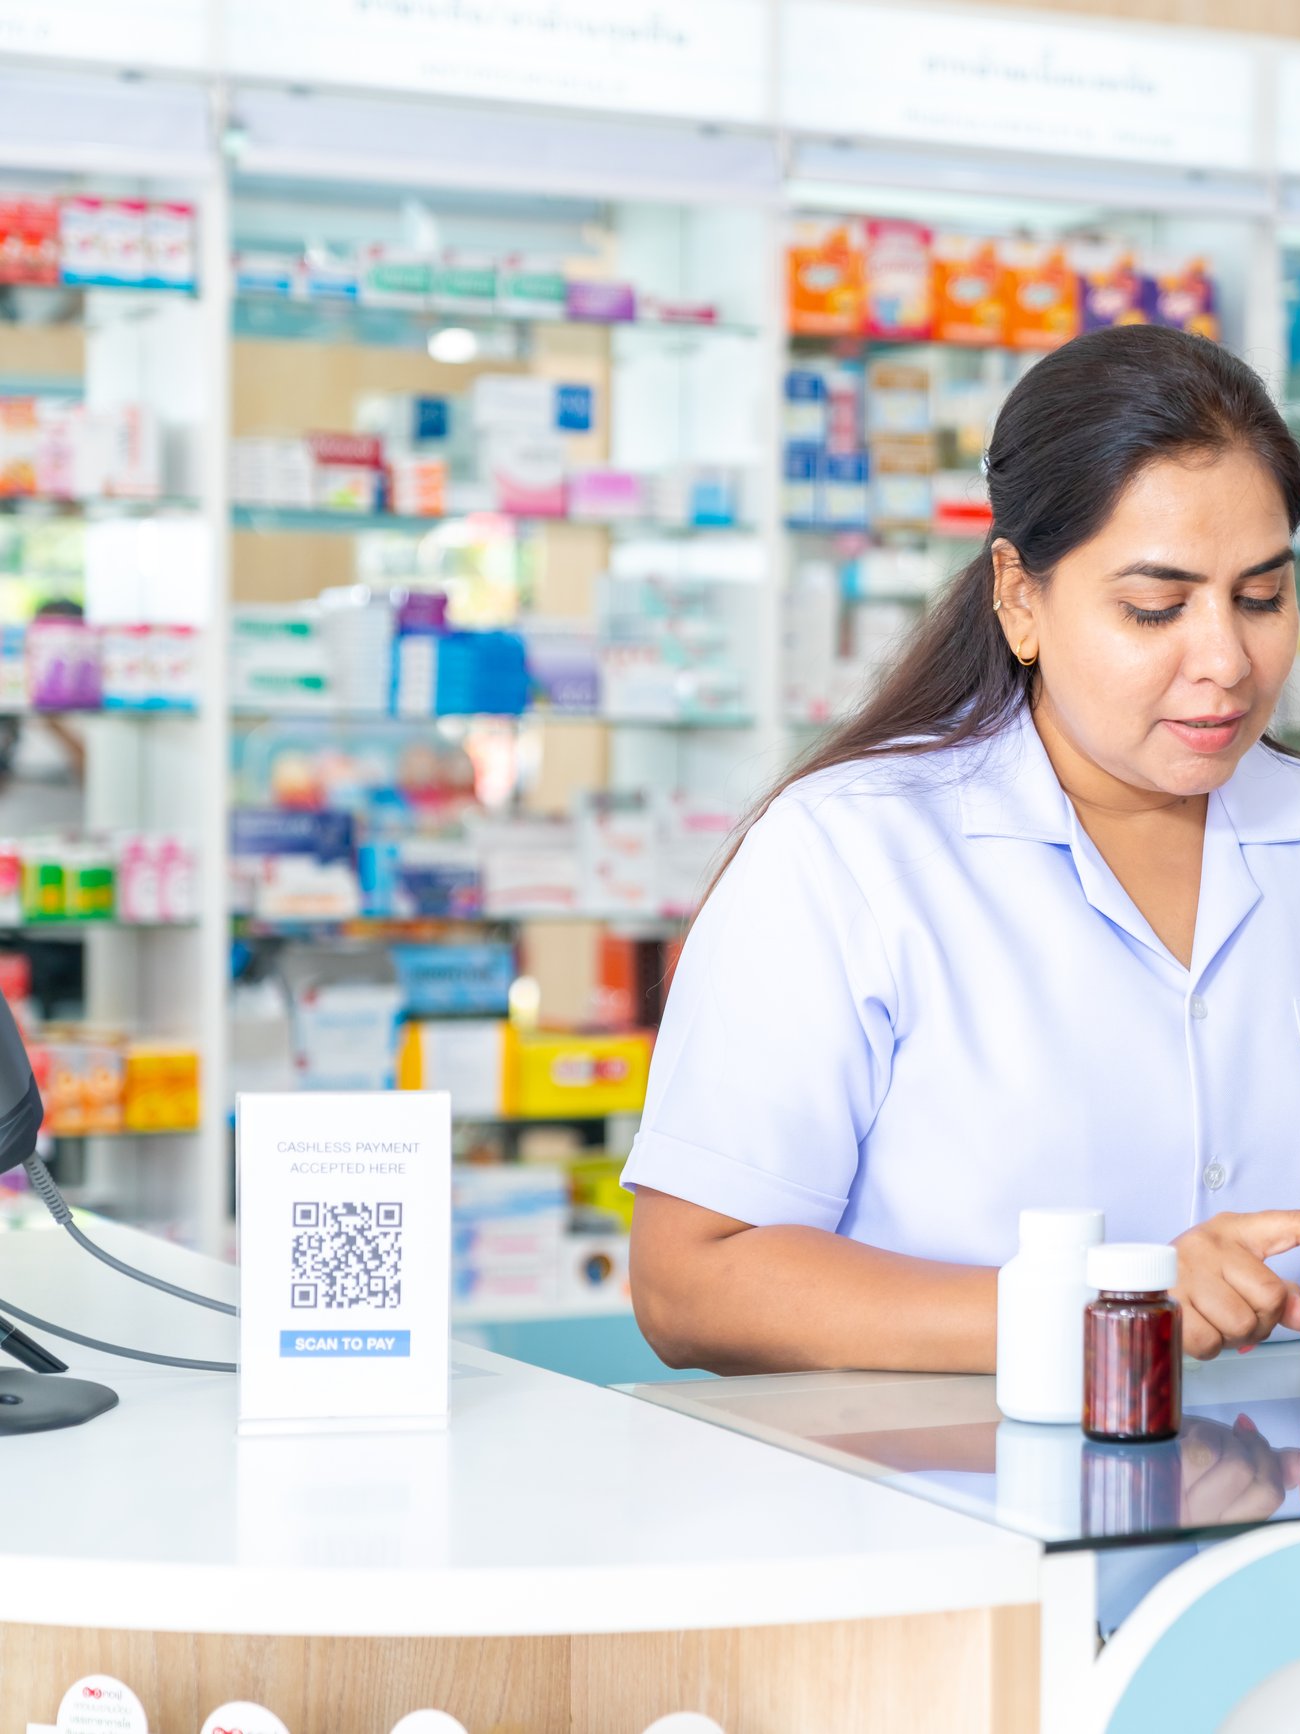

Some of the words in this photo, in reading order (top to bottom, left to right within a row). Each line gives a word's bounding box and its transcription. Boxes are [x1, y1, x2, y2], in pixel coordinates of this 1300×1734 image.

[277, 1141, 352, 1153] CASHLESS
[355, 1141, 420, 1154] PAYMENT
[290, 1162, 366, 1174] ACCEPTED
[369, 1162, 406, 1175] HERE
[294, 1337, 338, 1351] SCAN
[341, 1337, 363, 1351] TO
[366, 1337, 396, 1350] PAY
